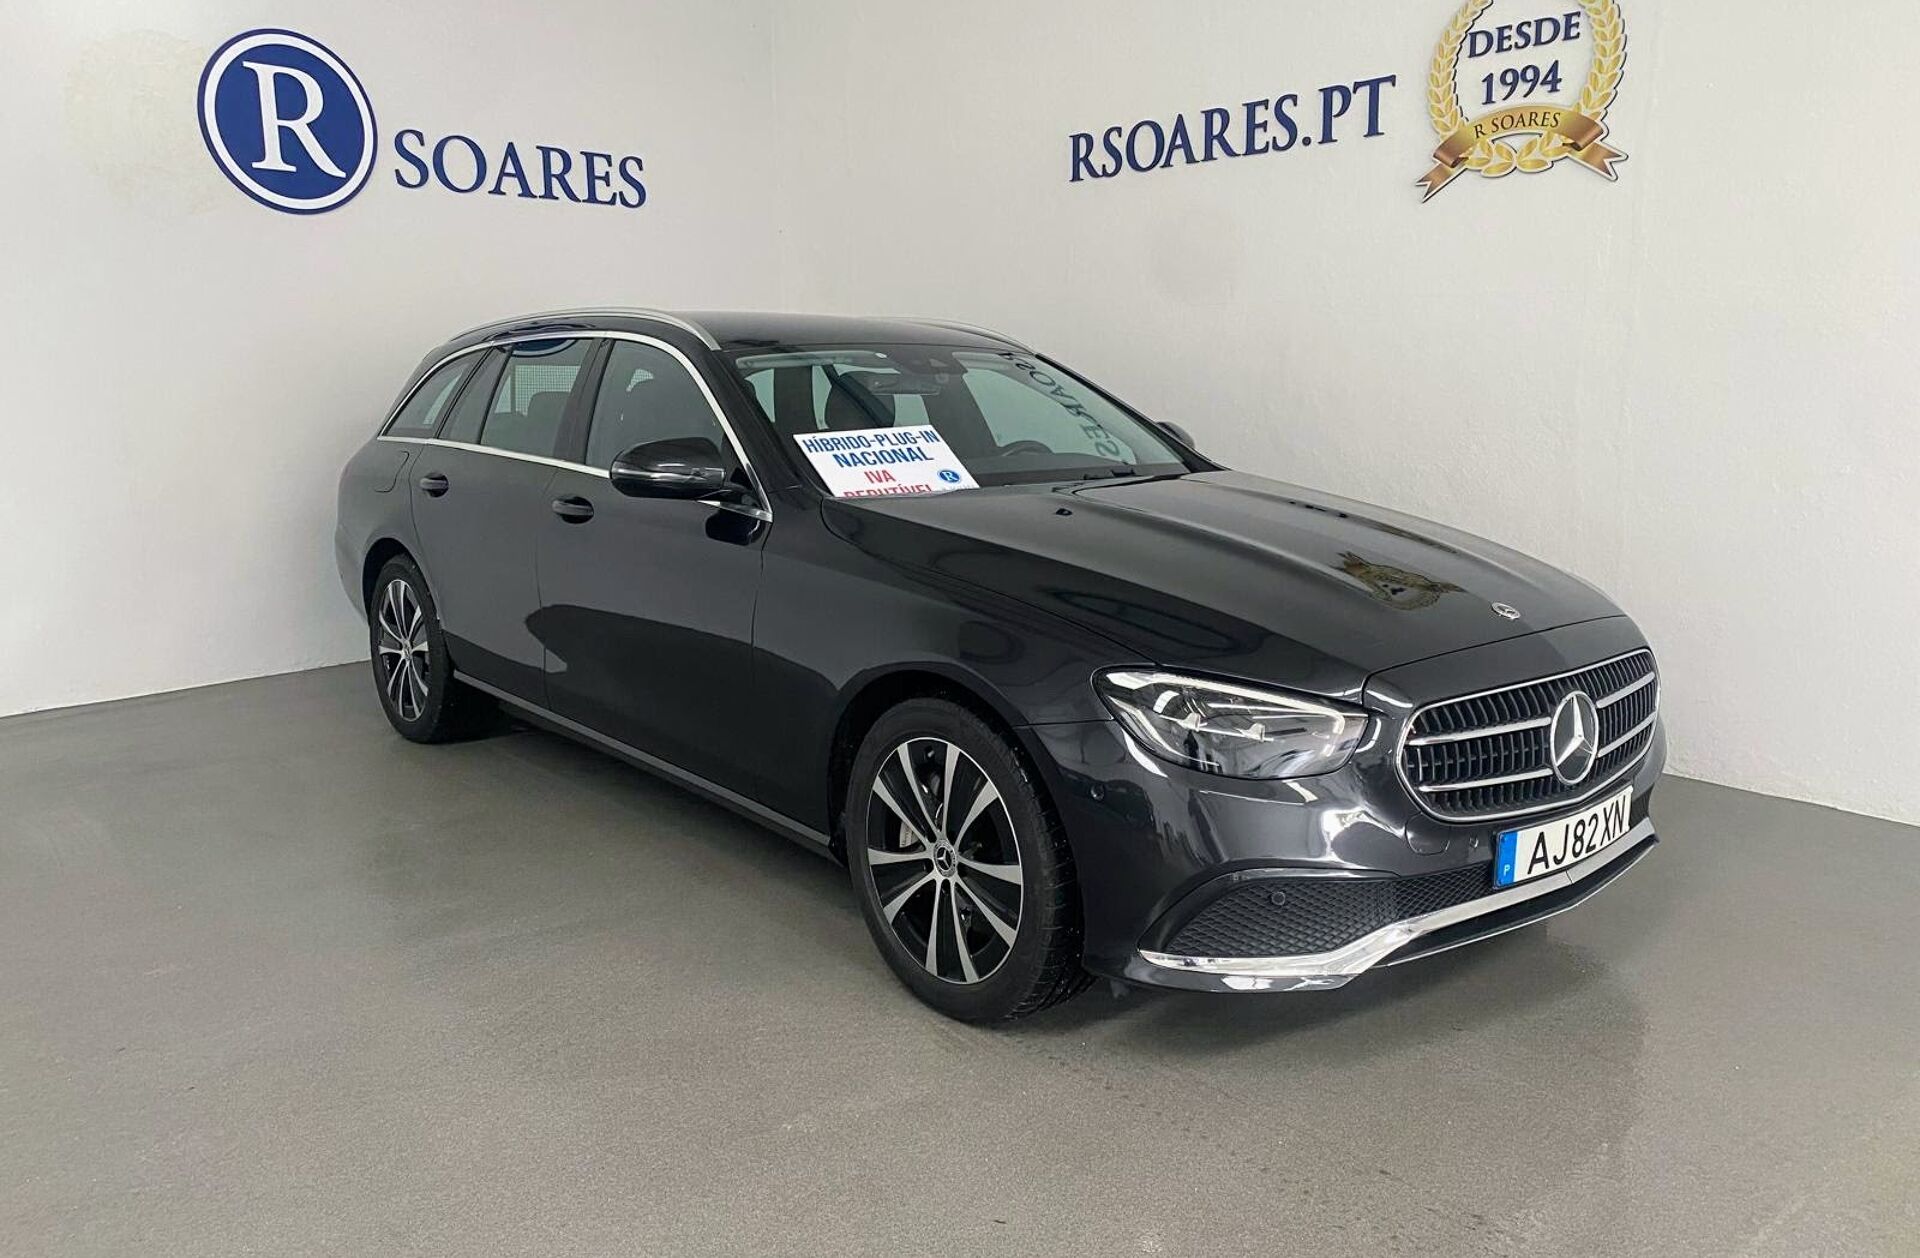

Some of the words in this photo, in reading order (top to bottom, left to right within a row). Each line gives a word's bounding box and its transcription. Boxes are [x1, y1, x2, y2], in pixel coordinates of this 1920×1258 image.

[1467, 11, 1581, 59] DESDE
[1481, 60, 1562, 105] 1994
[242, 60, 347, 178] R
[394, 129, 647, 209] SOARES
[1069, 74, 1396, 182] RSOARES.PT
[1474, 123, 1487, 139] R
[1490, 111, 1561, 133] SOARES
[802, 430, 941, 453] HÍBRIDO-PLUG-IN
[833, 446, 934, 468] NACIONAL
[864, 470, 896, 484] IVA
[1504, 864, 1511, 877] P
[1526, 794, 1626, 875] AJ82XN
